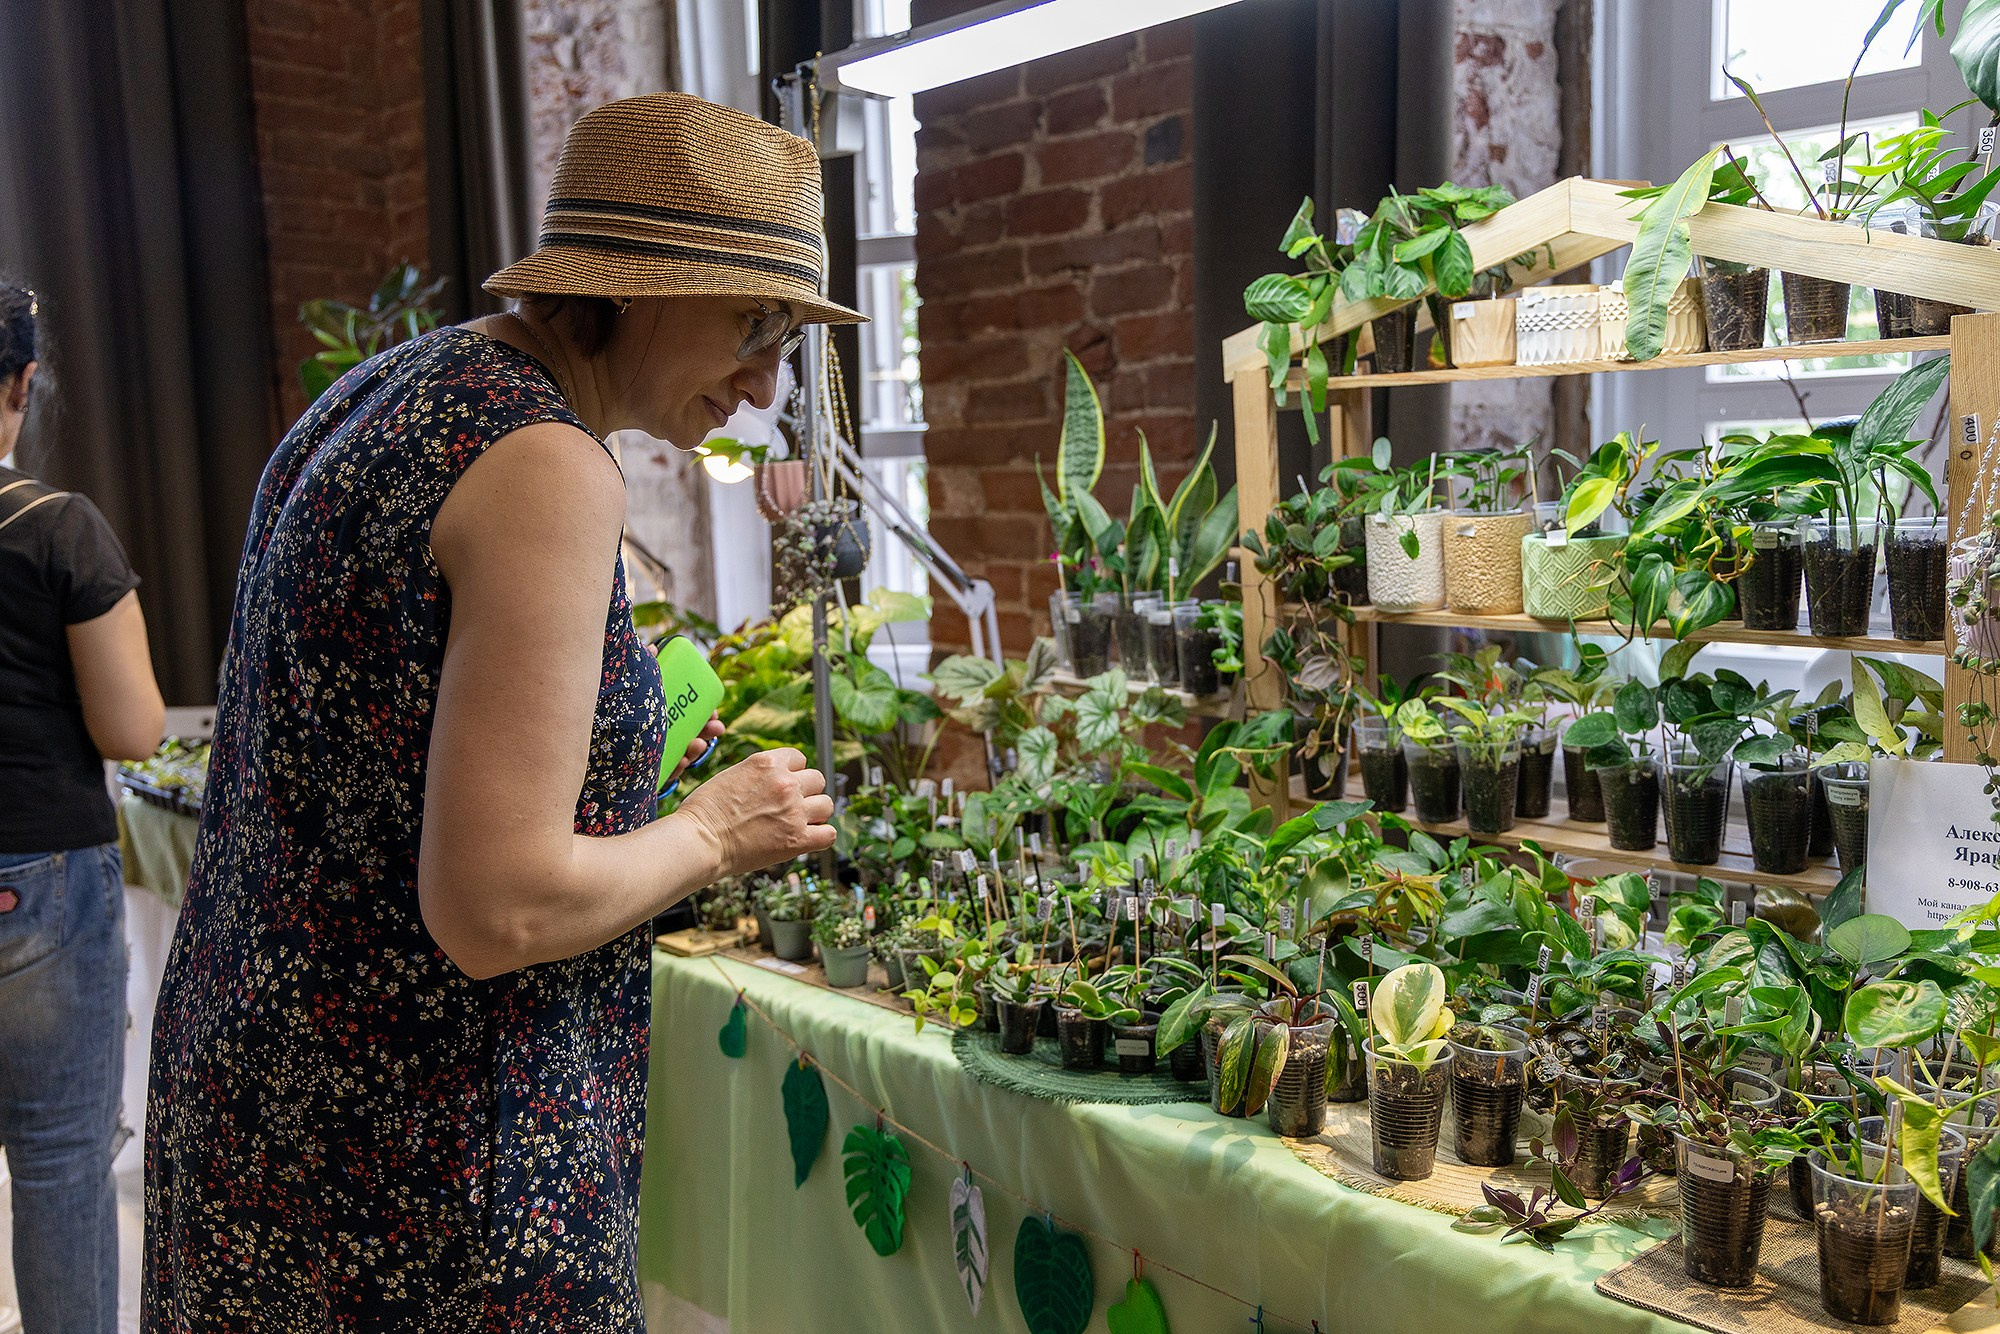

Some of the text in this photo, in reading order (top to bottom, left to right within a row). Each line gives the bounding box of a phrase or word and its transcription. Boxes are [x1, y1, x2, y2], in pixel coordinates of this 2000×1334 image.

[1981, 130, 1993, 151] 350
[1826, 162, 1836, 182] 250
[1965, 417, 1977, 442] 400
[1808, 713, 1816, 733] 250
[1945, 824, 2000, 843] Алекс
[1948, 878, 1999, 892] 8-908-63
[1039, 900, 1048, 918] 350
[1108, 900, 1117, 918] 350
[1582, 898, 1593, 916] 200
[1917, 897, 1938, 907] Мой
[1282, 909, 1290, 926] 400
[1362, 937, 1371, 955] 400
[1538, 948, 1549, 970] 200
[1674, 964, 1684, 987] 200
[1356, 983, 1367, 1006] 300
[1528, 977, 1537, 998] 150
[1595, 1010, 1606, 1030] 150
